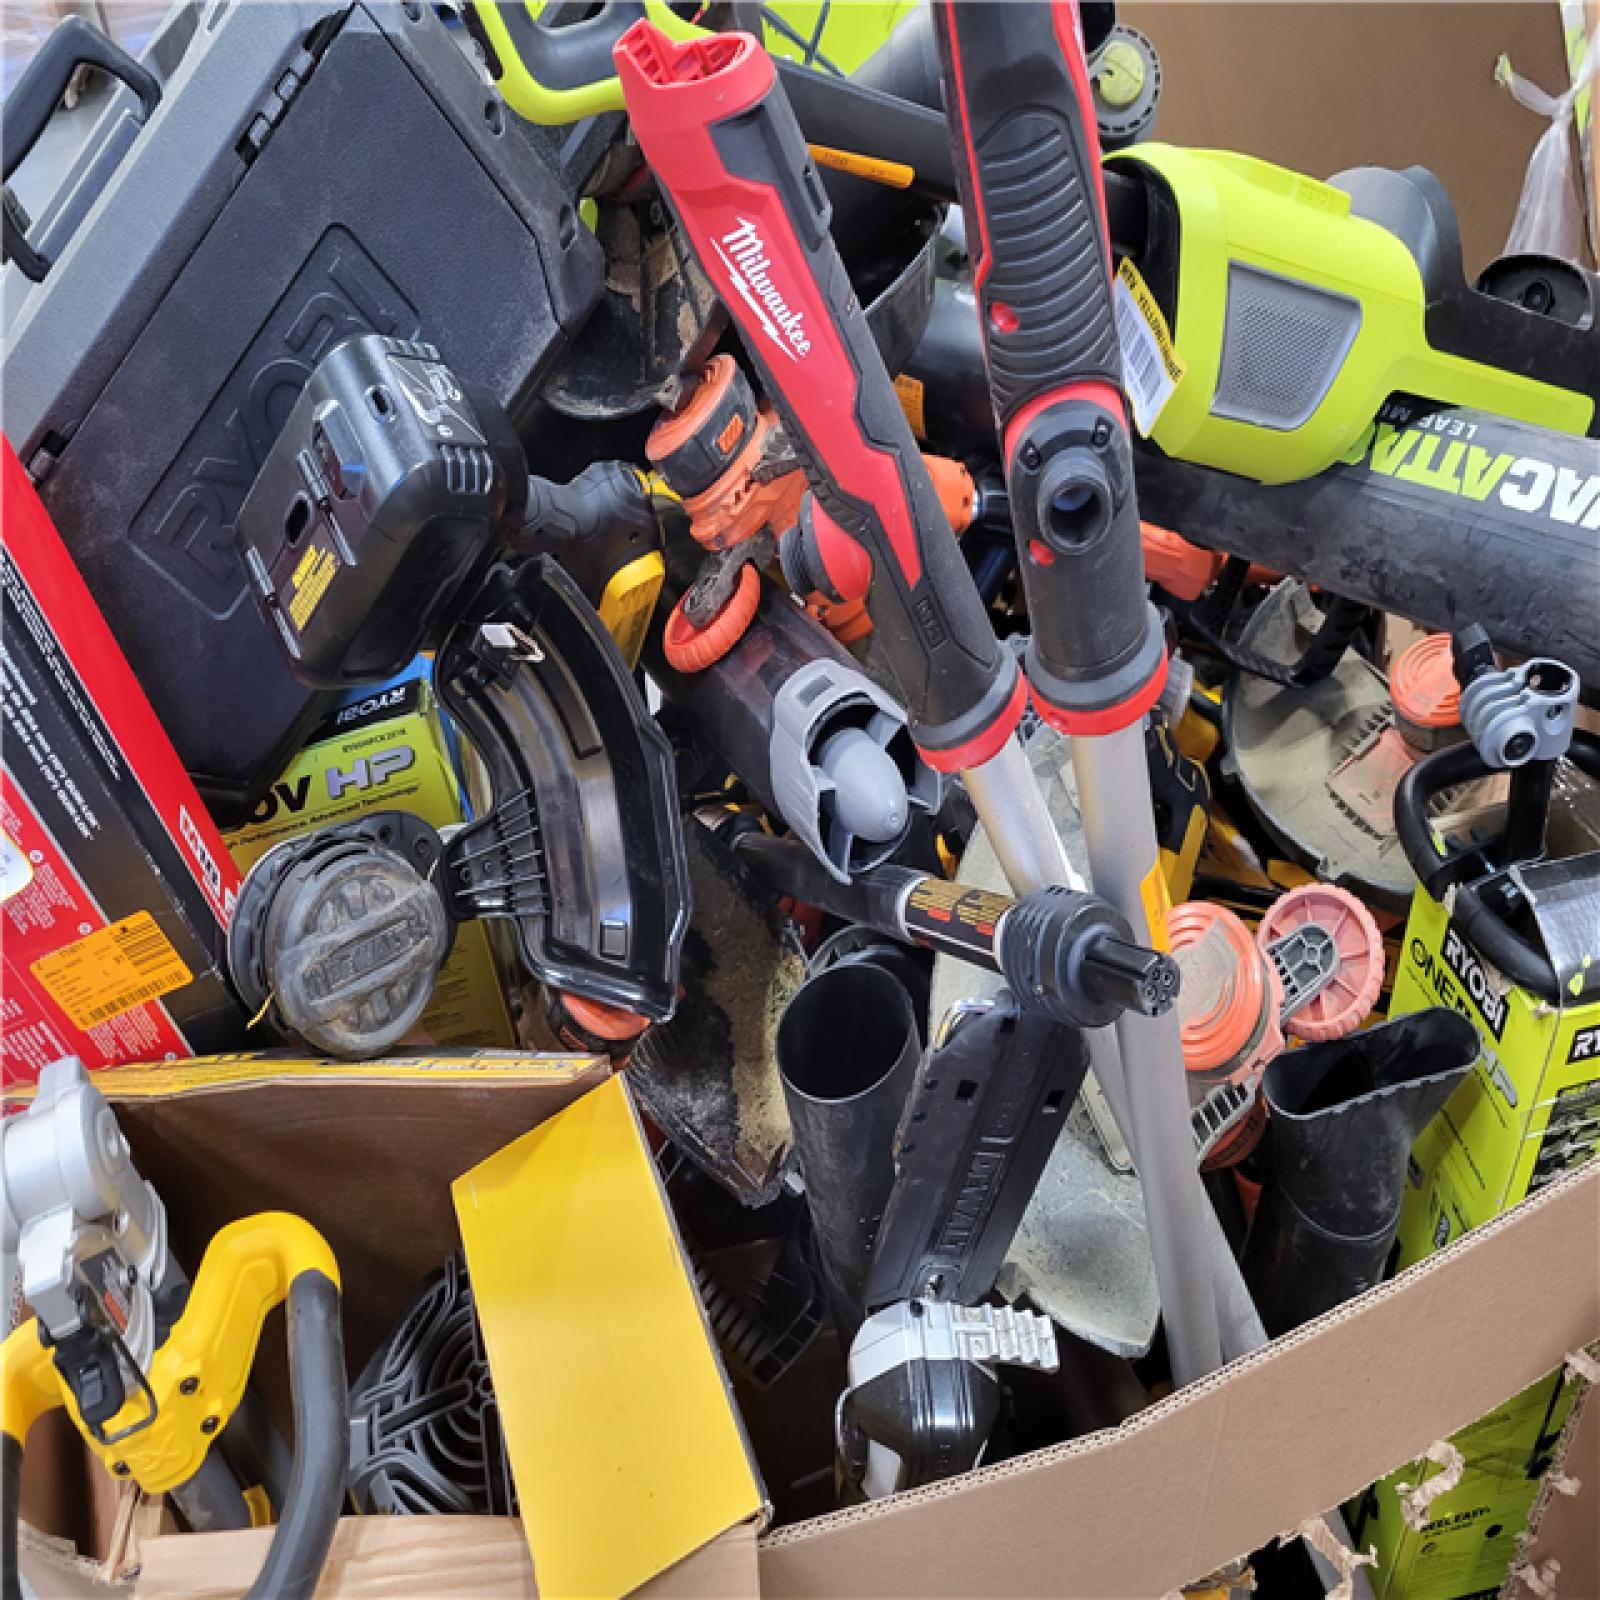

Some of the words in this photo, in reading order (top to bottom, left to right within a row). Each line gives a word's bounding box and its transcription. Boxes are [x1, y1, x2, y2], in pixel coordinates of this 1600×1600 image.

[720, 216, 811, 357] Milwaukee
[1417, 414, 1478, 441] LEAF
[325, 745, 415, 801] HP
[1445, 922, 1505, 1031] RYOBI
